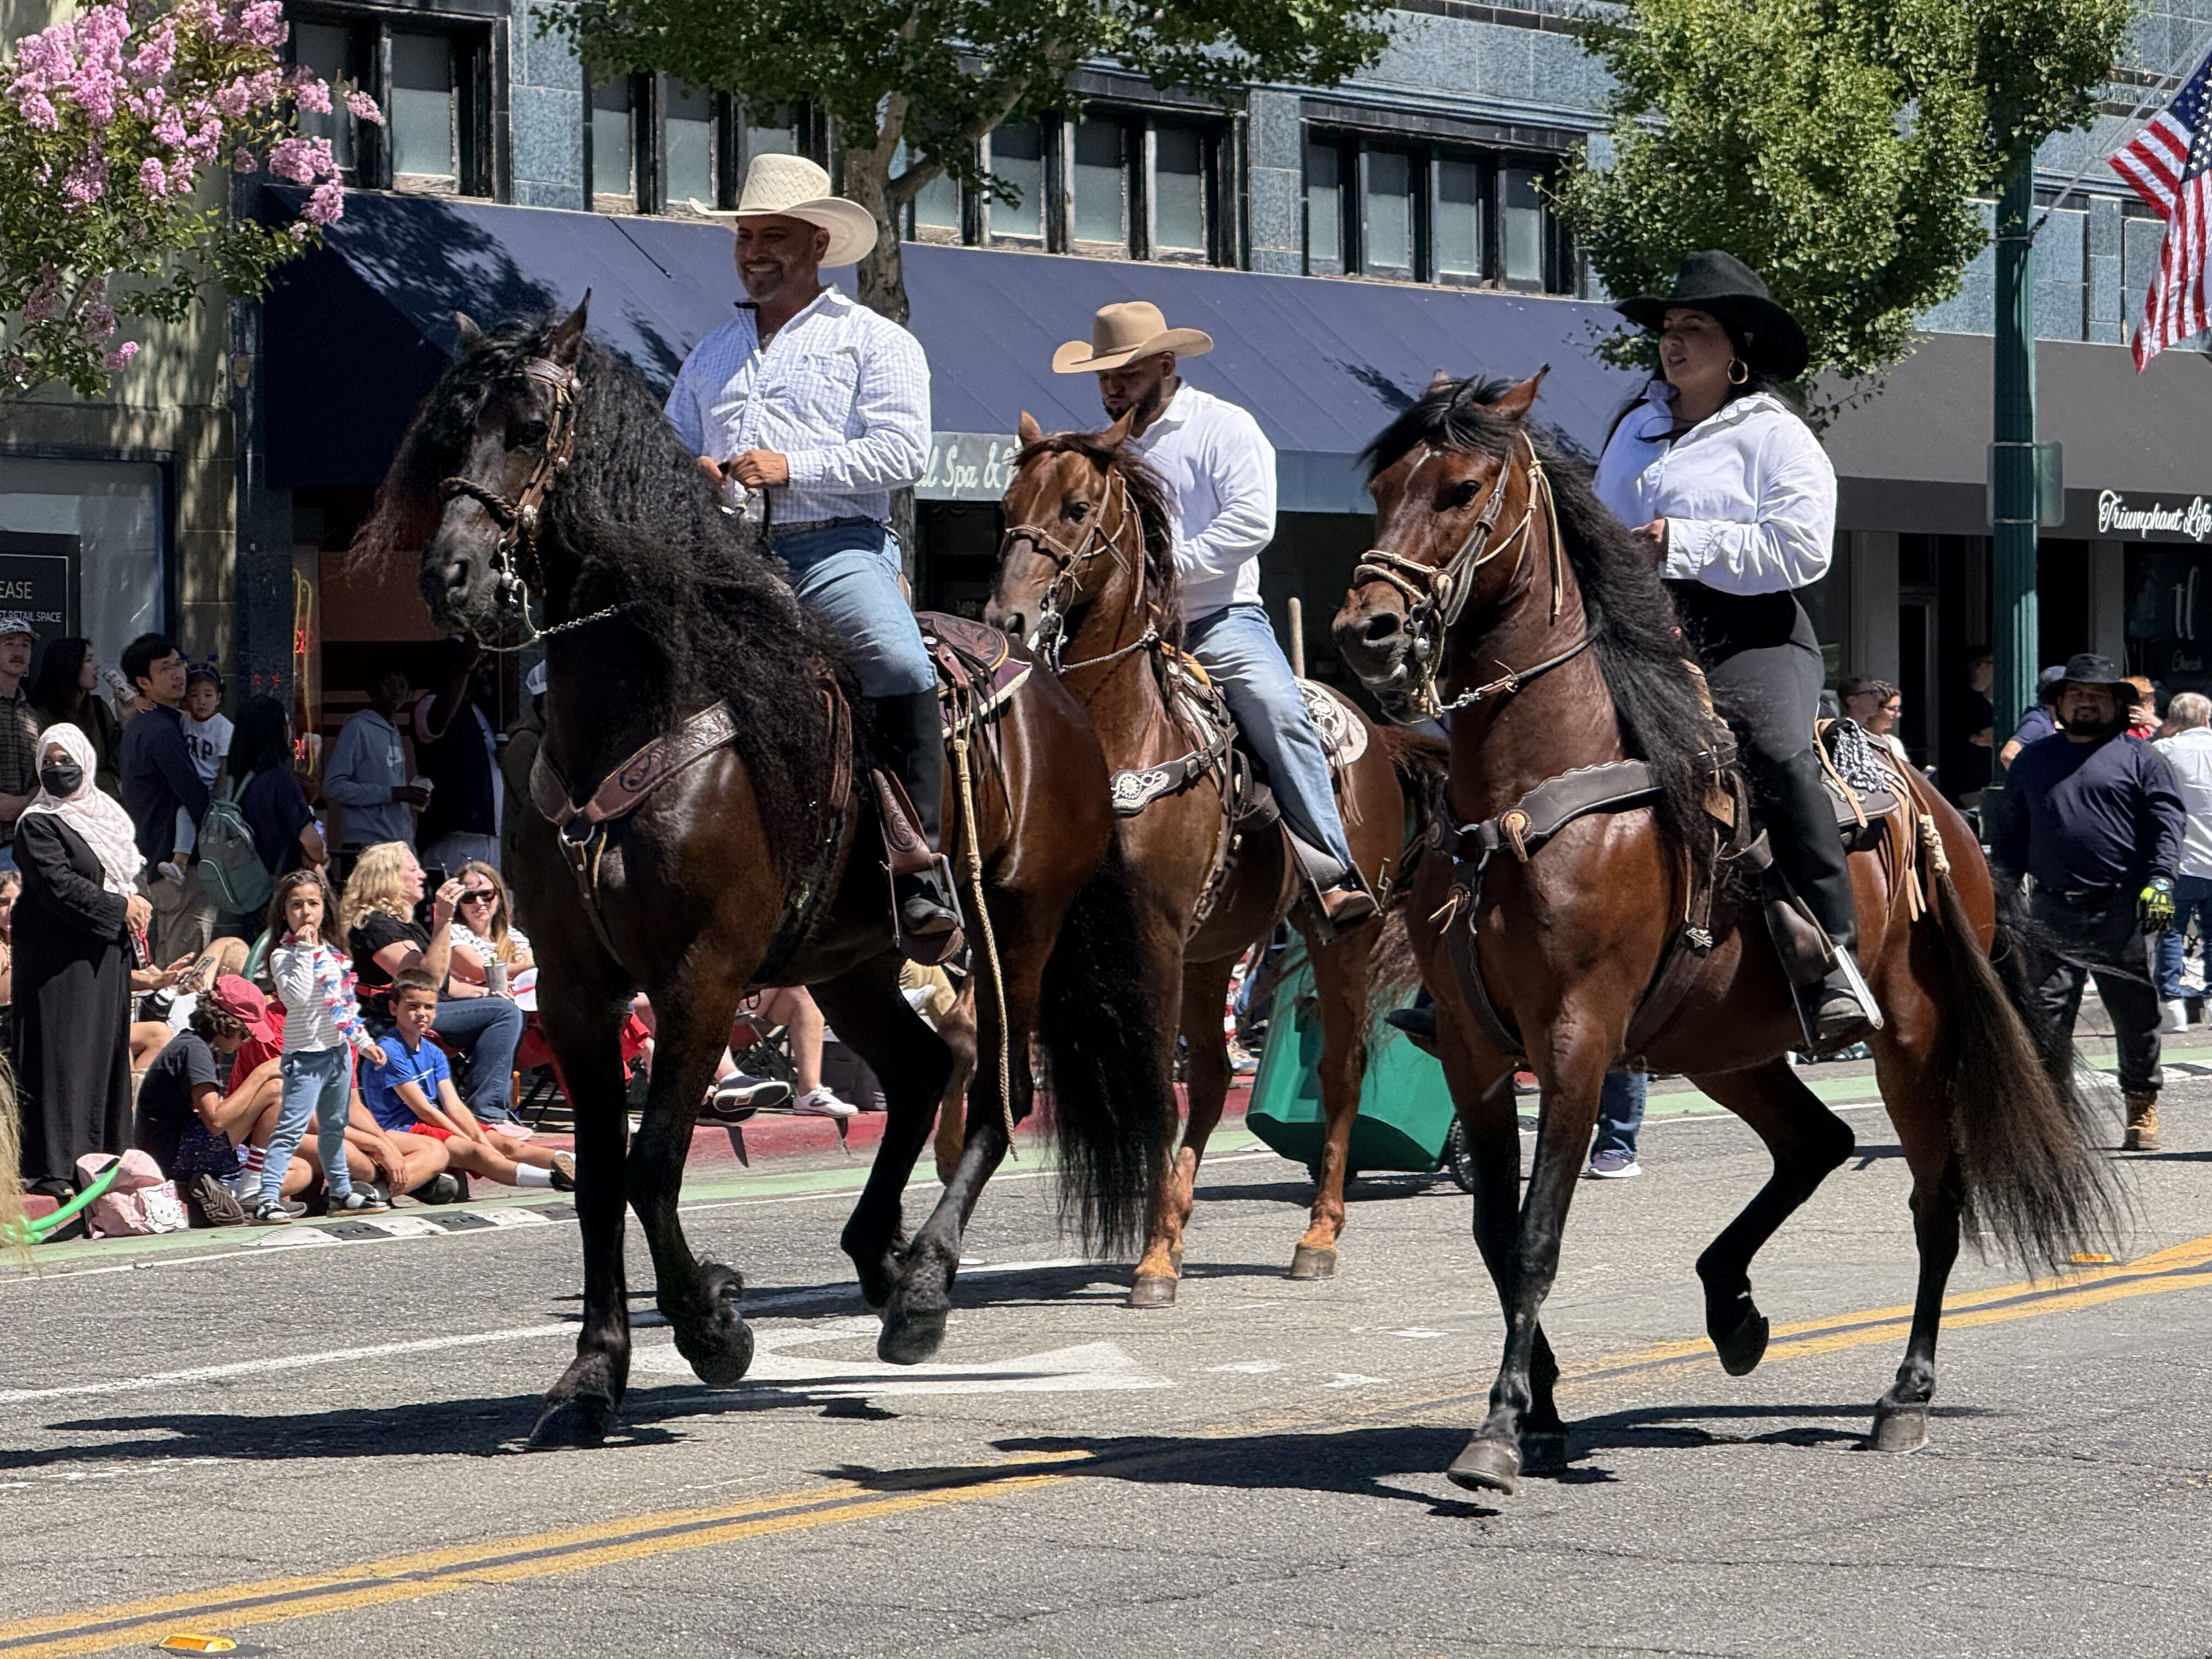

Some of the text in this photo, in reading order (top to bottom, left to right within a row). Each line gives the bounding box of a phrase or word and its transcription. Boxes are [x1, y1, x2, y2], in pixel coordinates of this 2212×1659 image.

[941, 445, 978, 497] Spa
[984, 441, 1002, 488] &
[2098, 489, 2212, 542] Triumphant Life
[8, 610, 35, 622] RETAIL
[36, 611, 62, 623] SPACE
